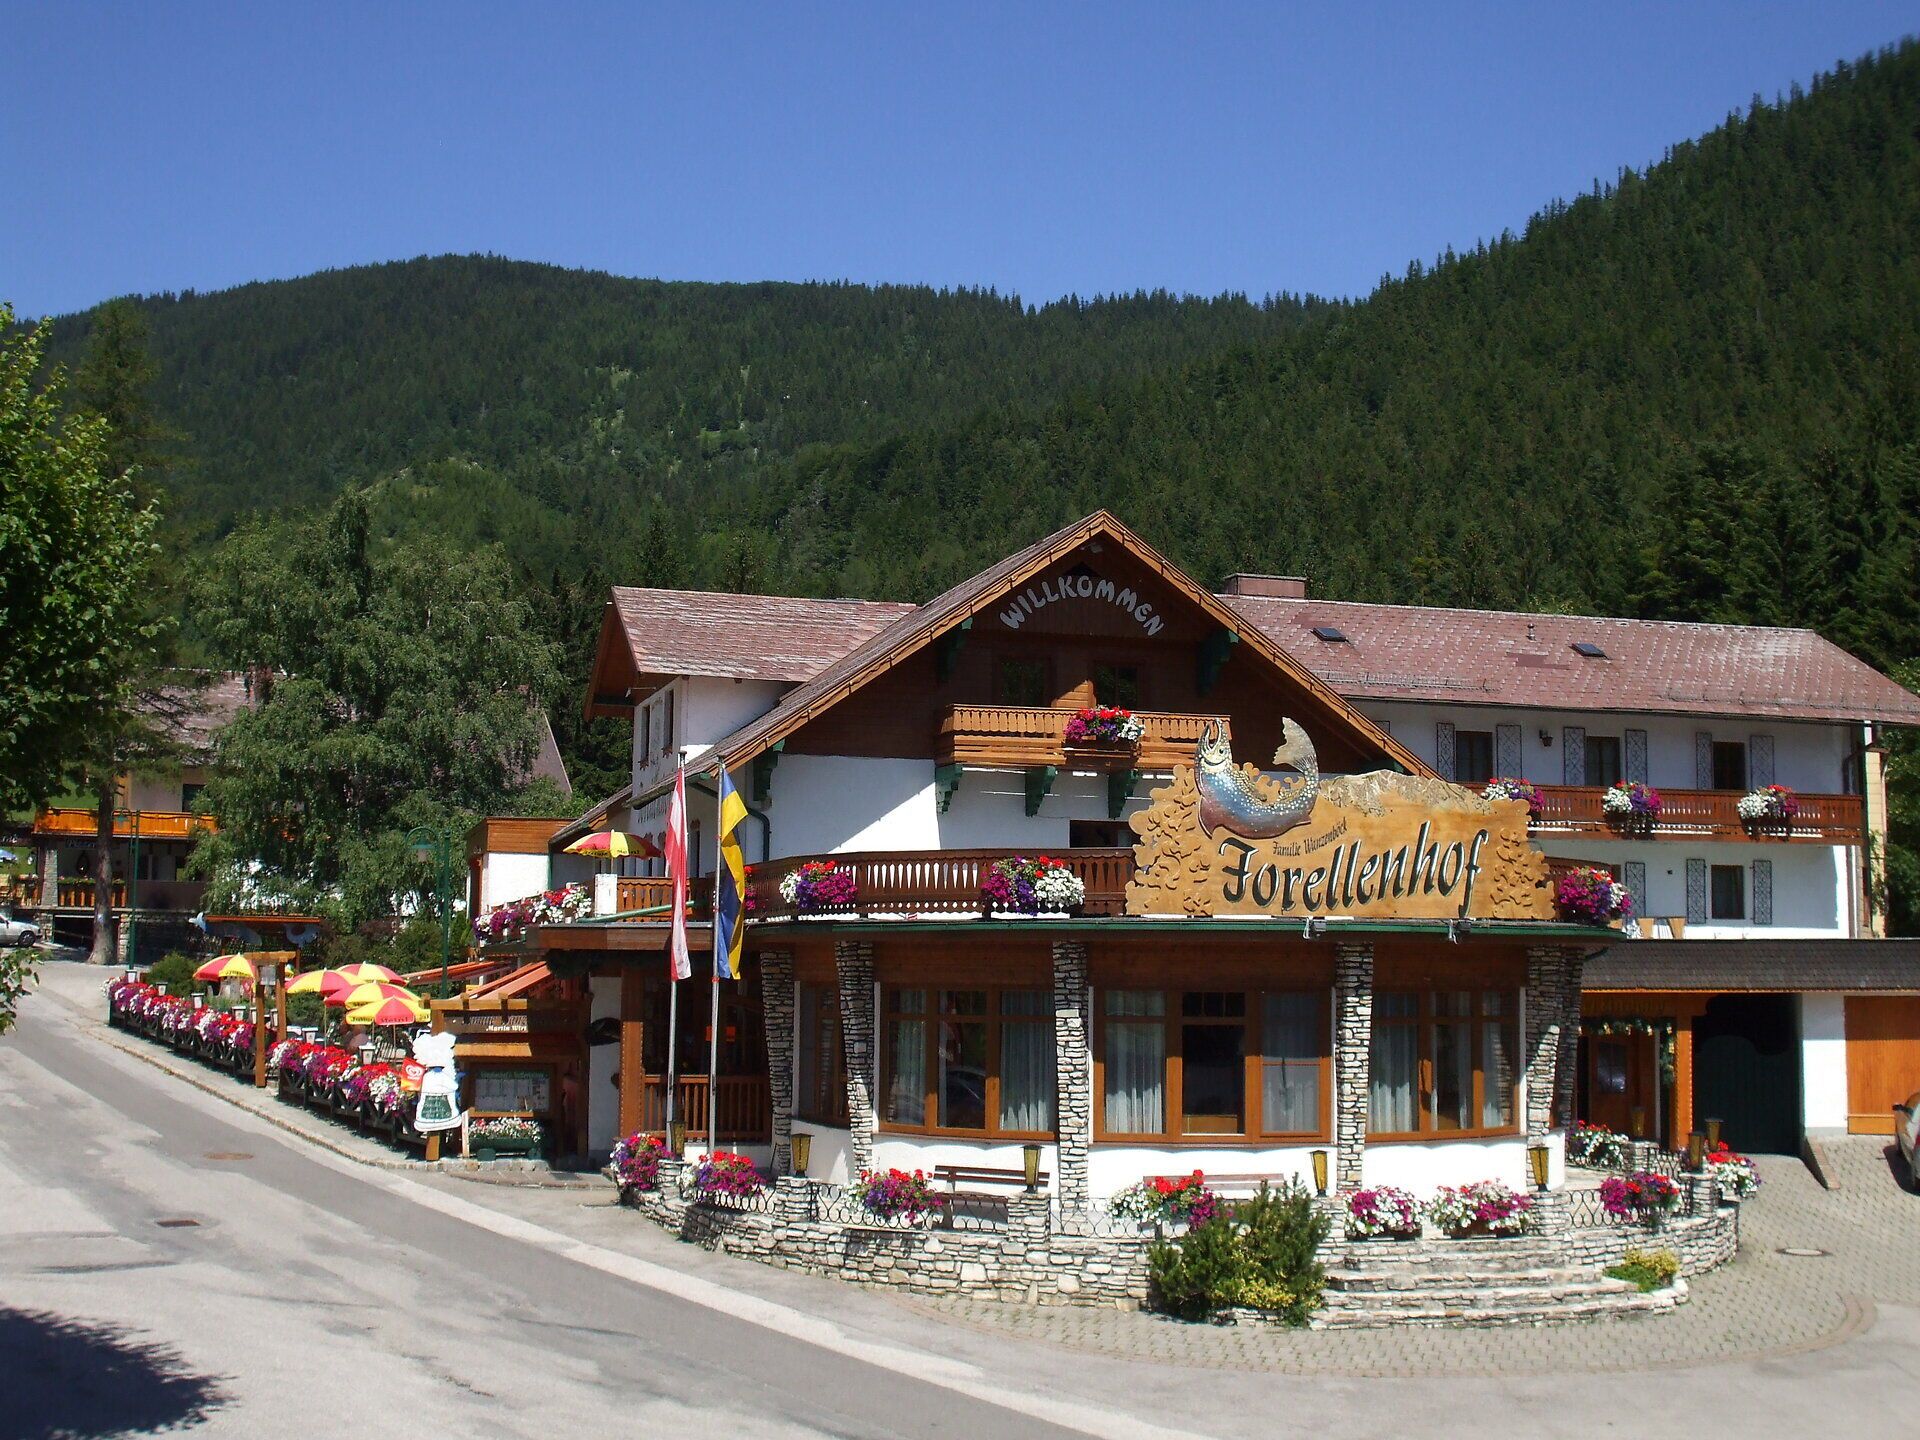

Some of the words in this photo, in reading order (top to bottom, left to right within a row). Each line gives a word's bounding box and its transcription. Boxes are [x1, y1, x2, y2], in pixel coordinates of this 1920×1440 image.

[999, 575, 1165, 637] WILLKOMMEN
[1218, 820, 1490, 918] Forellenhof
[1272, 840, 1301, 857] Familie
